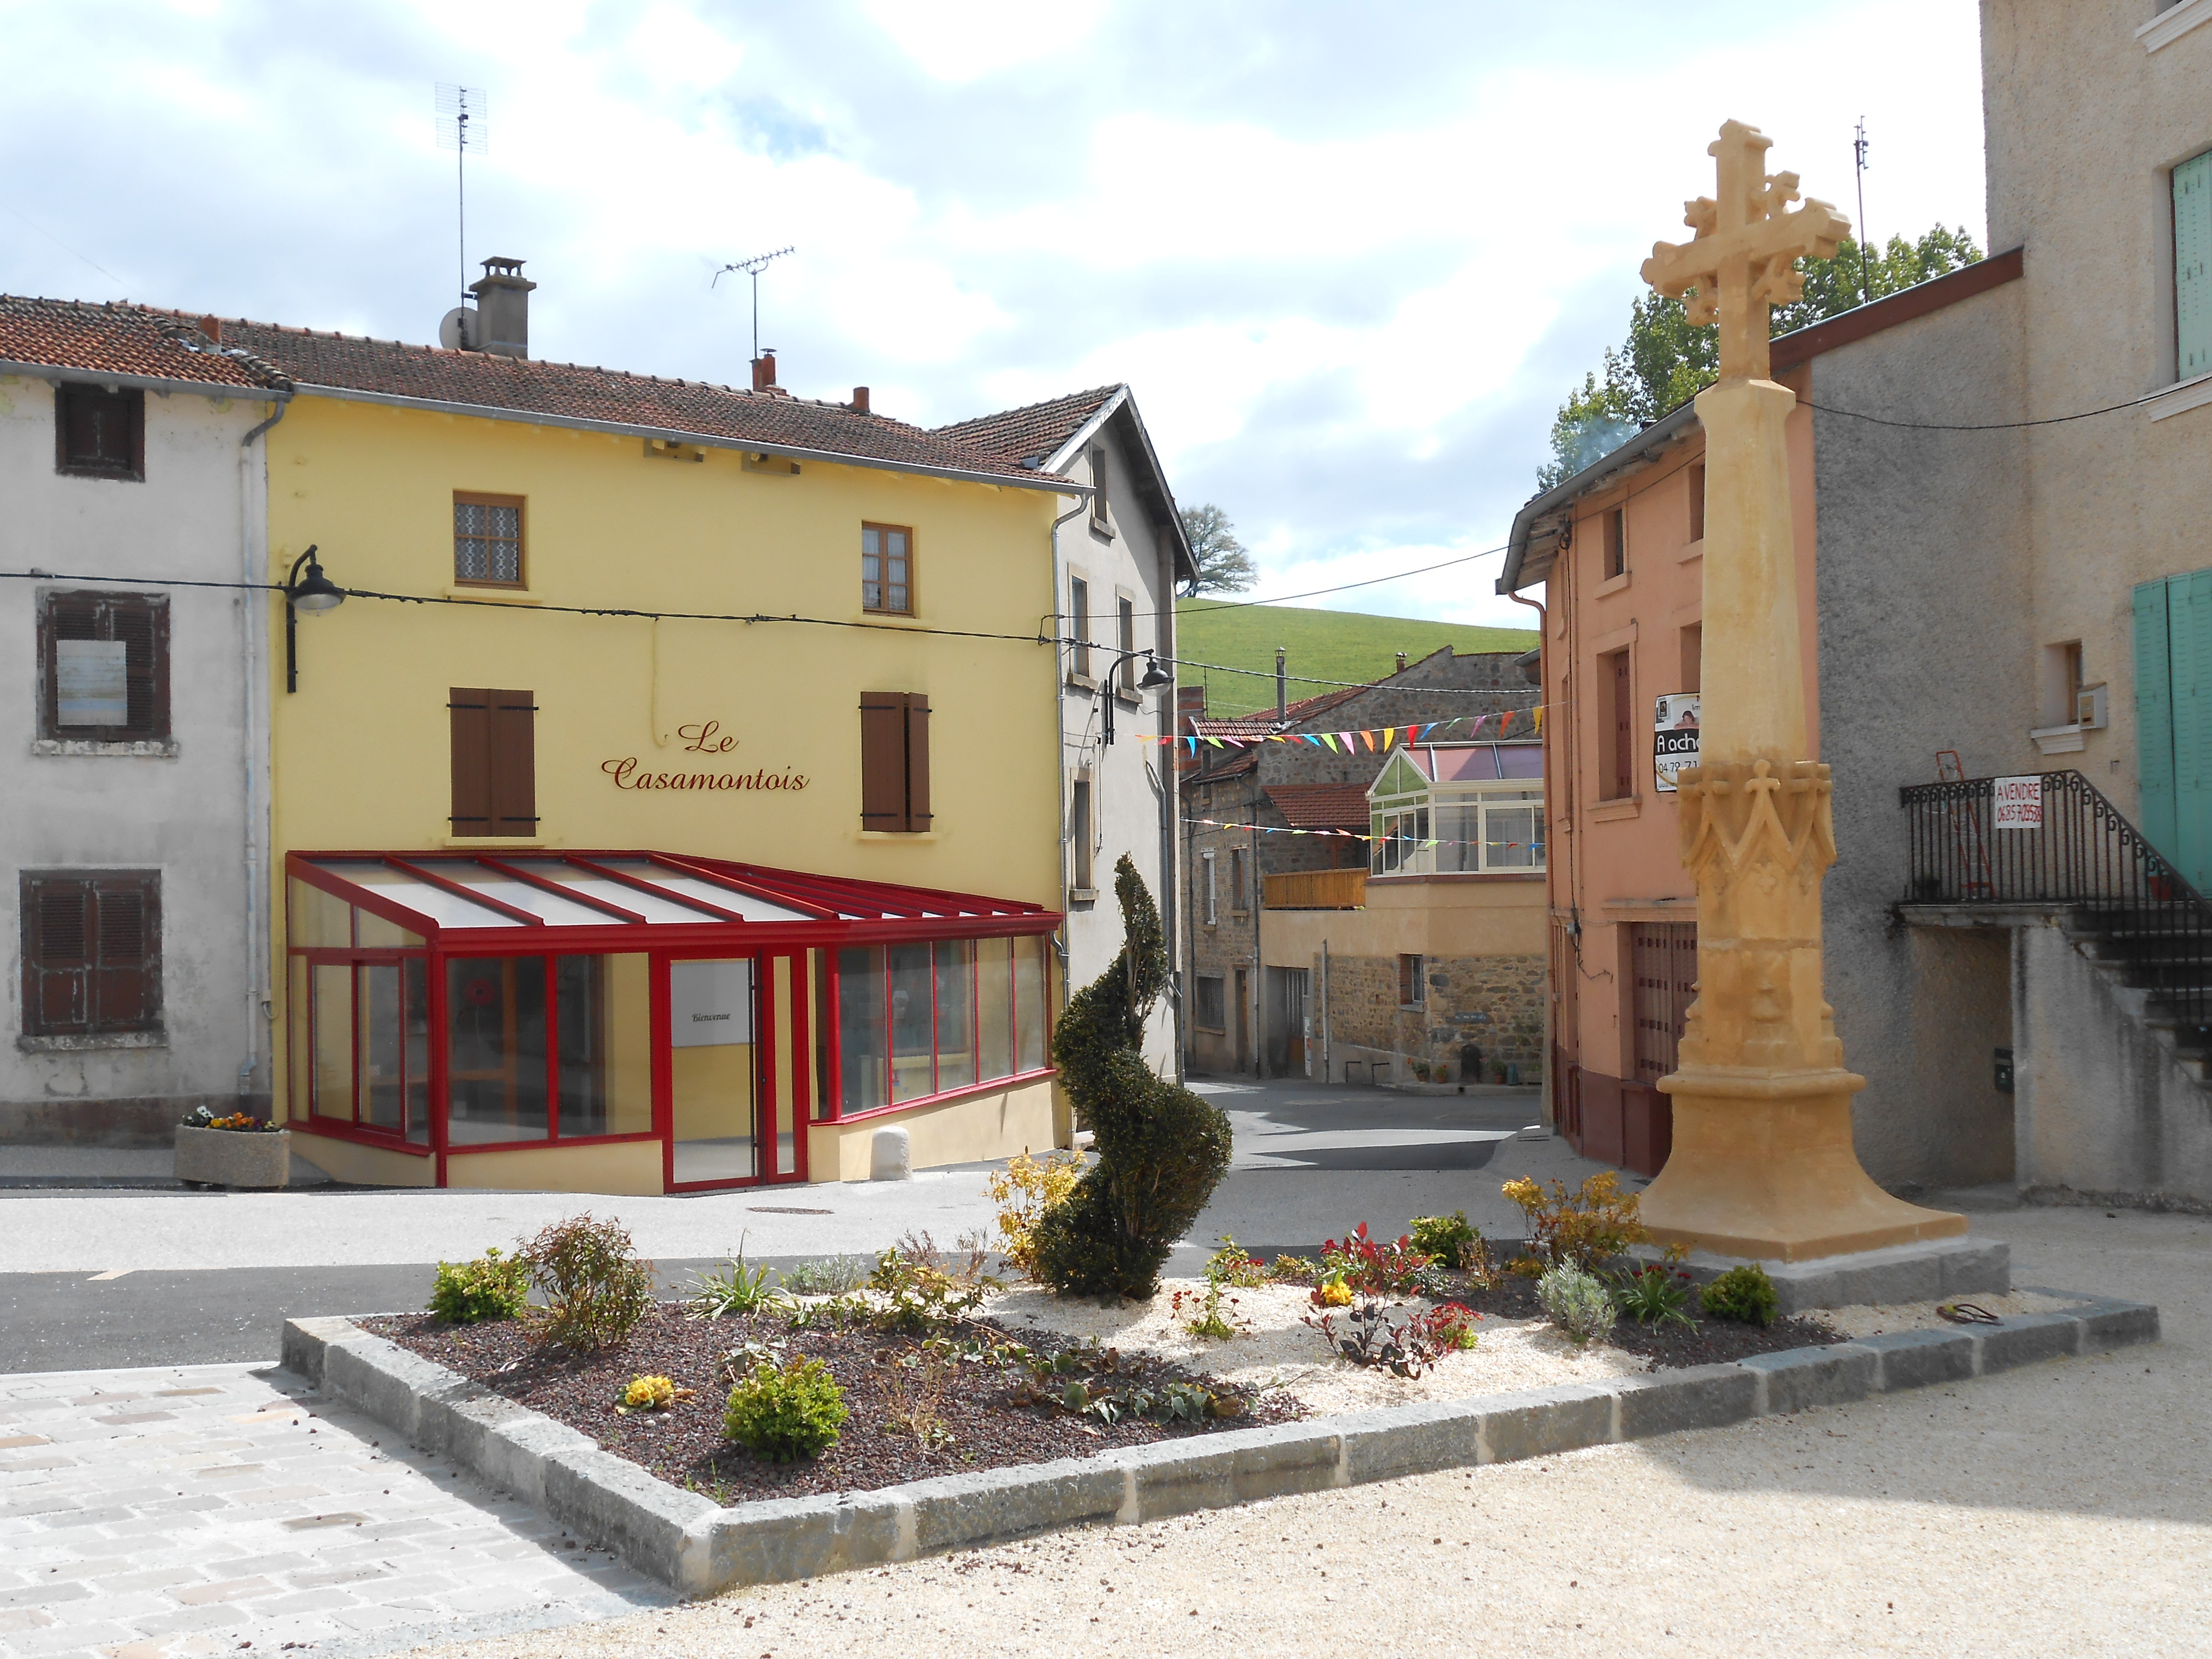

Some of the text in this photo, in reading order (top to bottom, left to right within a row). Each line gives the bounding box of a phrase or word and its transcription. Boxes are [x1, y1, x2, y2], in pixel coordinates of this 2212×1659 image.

[678, 721, 739, 753] Le
[1657, 735, 1665, 753] A
[601, 757, 810, 791] Casamontois
[1659, 763, 1668, 773] 04
[1997, 782, 2040, 801] A VENDRE
[692, 1013, 731, 1022] Bienvenue
